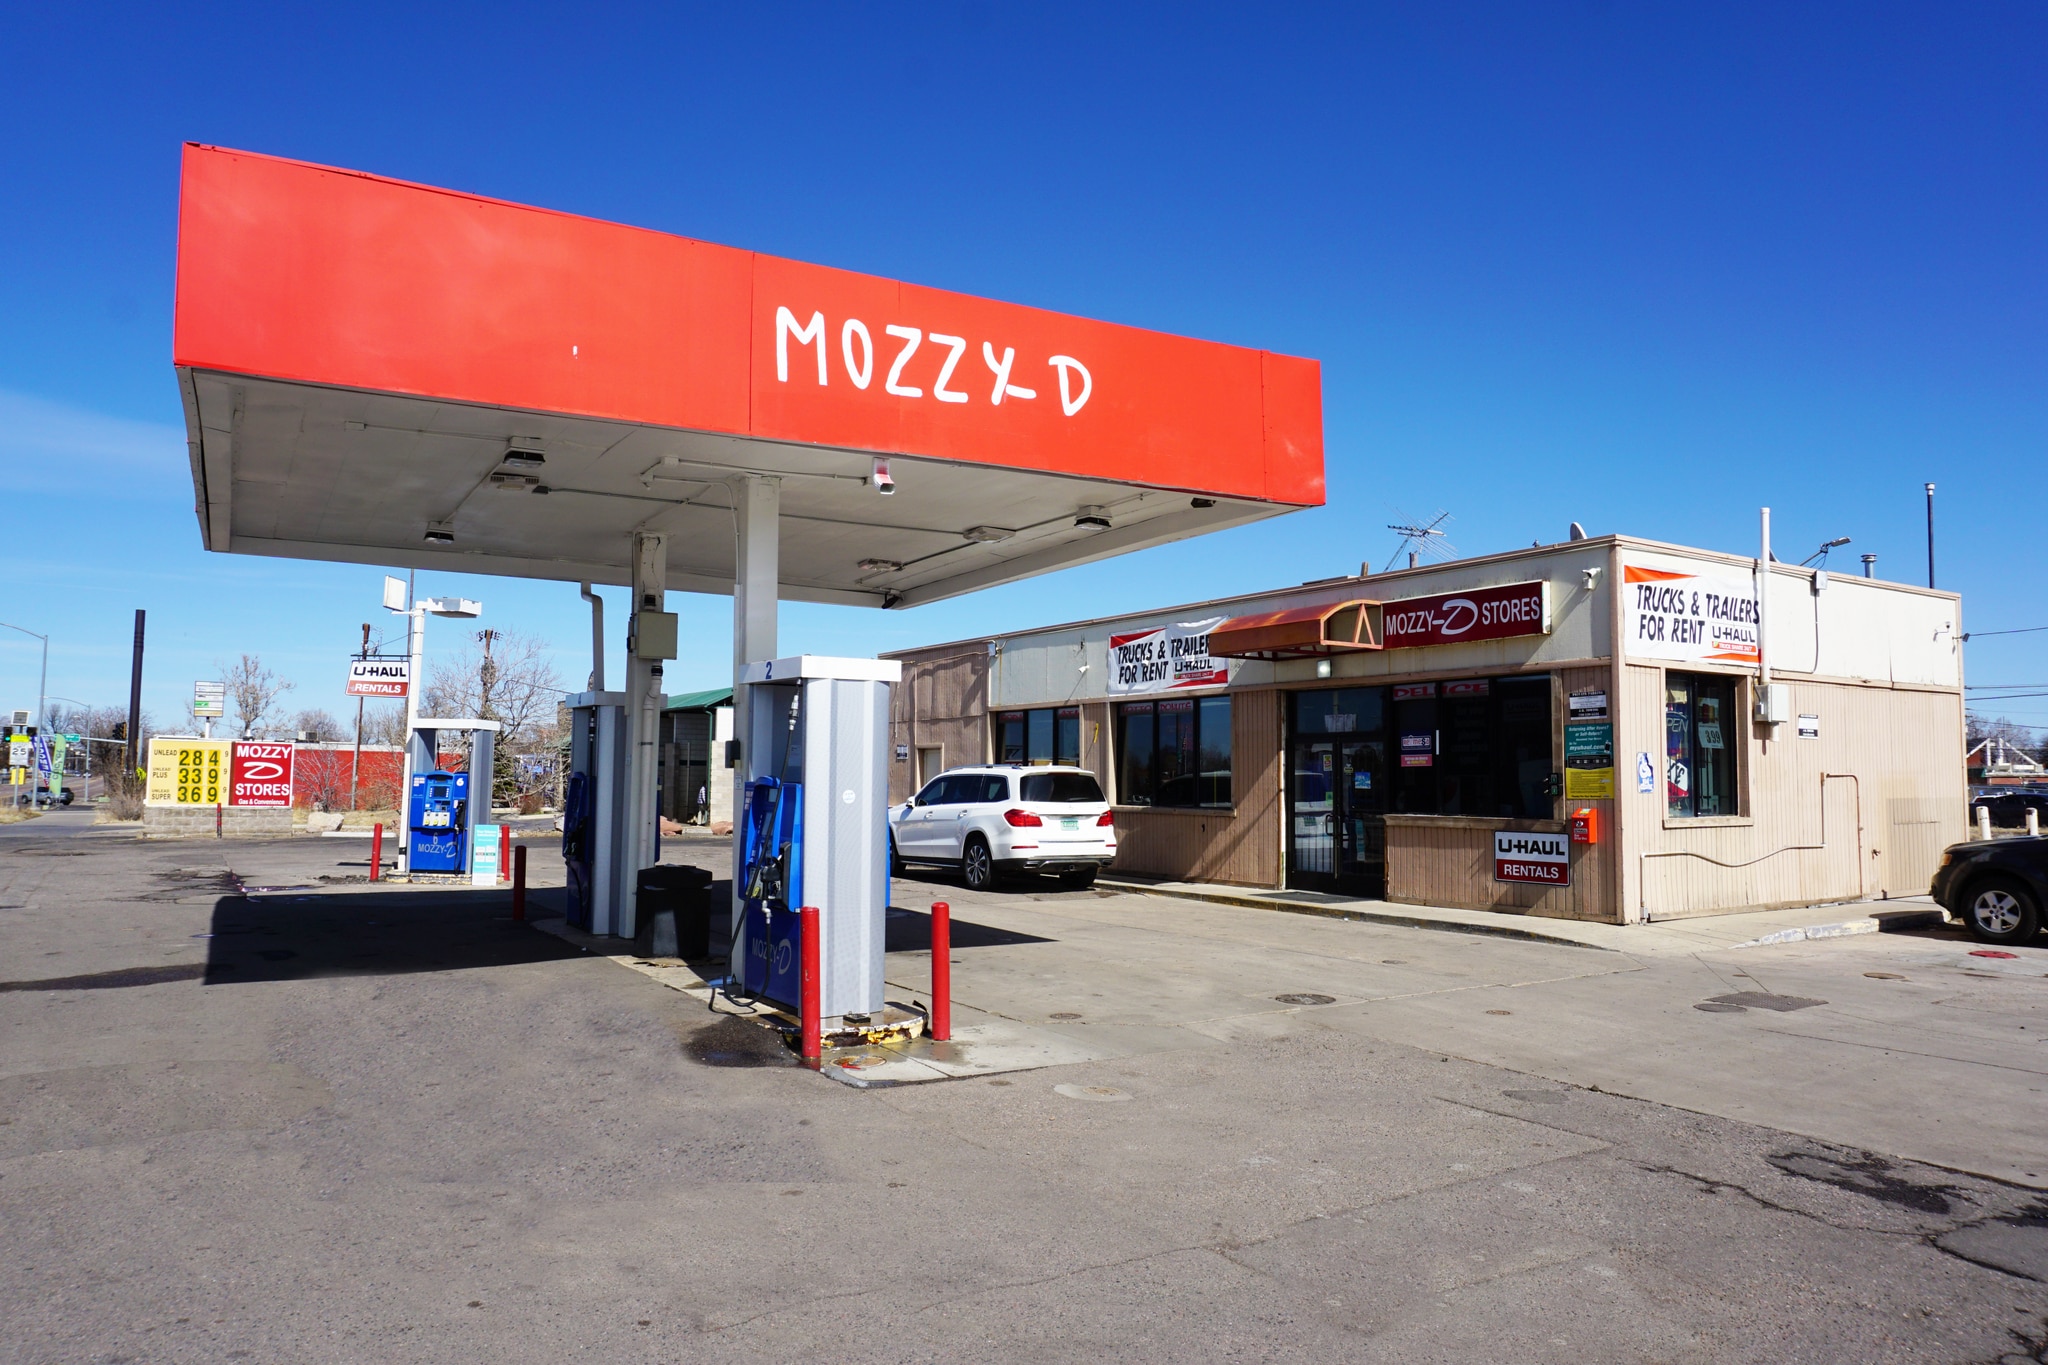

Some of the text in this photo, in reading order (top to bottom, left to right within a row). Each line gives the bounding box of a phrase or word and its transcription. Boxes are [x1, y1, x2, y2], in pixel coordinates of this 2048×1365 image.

[1637, 584, 1760, 625] TRUCKS & TRAILERS
[1386, 596, 1541, 636] MOZZY-D STORES
[1639, 614, 1705, 645] FOR RENT
[1712, 625, 1756, 643] U-HAUL
[1118, 641, 1153, 664] TRUCKS
[1158, 640, 1166, 660] &
[354, 666, 407, 677] U-HAUL
[765, 661, 773, 680] 2
[1119, 660, 1169, 684] FOR RENT
[1175, 658, 1213, 672] U-HAUL
[354, 683, 401, 694] RENTALS
[1667, 717, 1689, 733] PEN
[154, 749, 178, 757] UNLEAD
[236, 745, 291, 758] MOZZY
[235, 783, 290, 796] STORES
[456, 778, 464, 786] 6
[1498, 838, 1566, 856] U-HAUL
[1503, 864, 1559, 879] RENTALS
